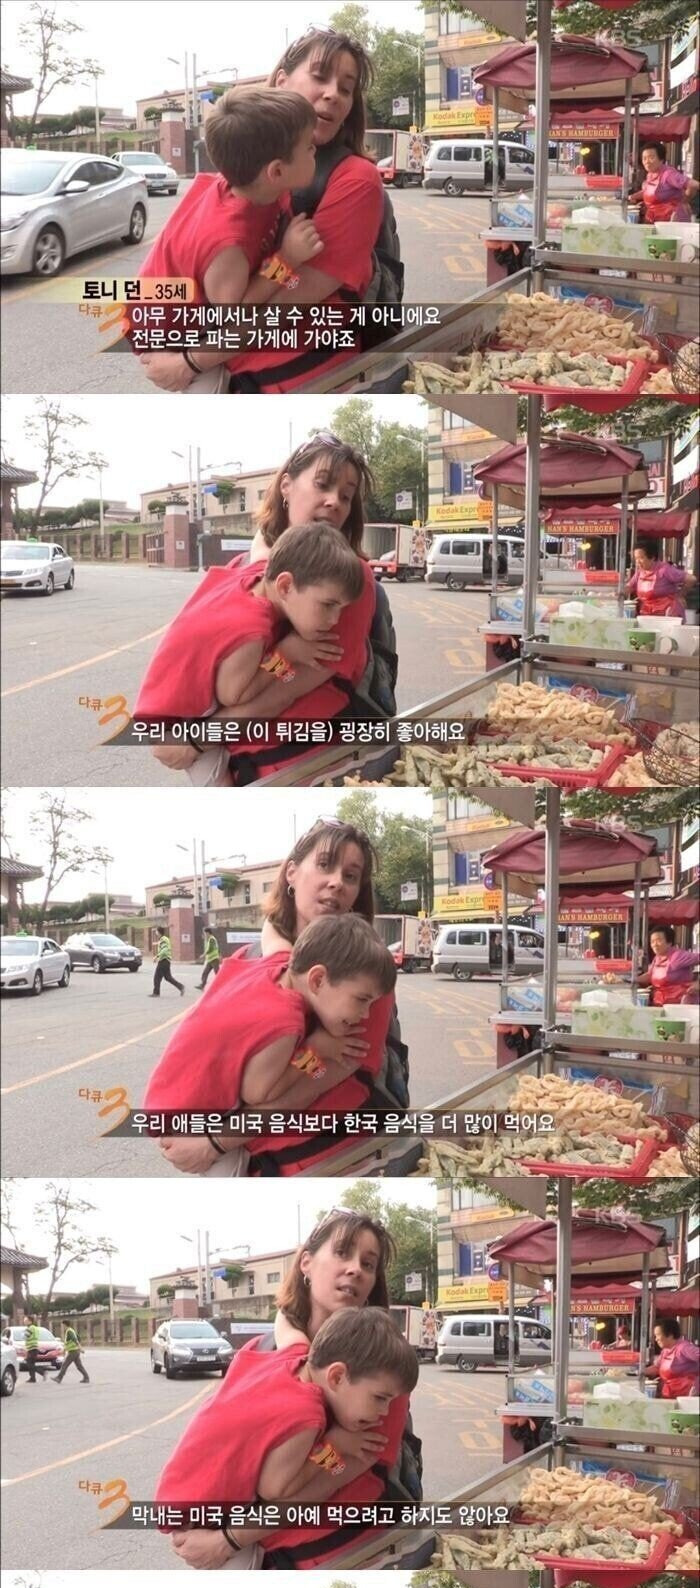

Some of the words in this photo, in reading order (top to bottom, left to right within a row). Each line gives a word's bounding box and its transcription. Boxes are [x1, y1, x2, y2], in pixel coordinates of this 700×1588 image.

[433, 111, 456, 121] Kodak
[568, 129, 614, 137] HAMBURGER
[436, 506, 459, 515] Kodak
[569, 525, 614, 533] HAMBURGER
[442, 897, 465, 906] Kodak
[578, 913, 623, 921] HAMBURGER
[446, 1288, 469, 1297] Kodak
[583, 1304, 629, 1312] HAMBURGER
